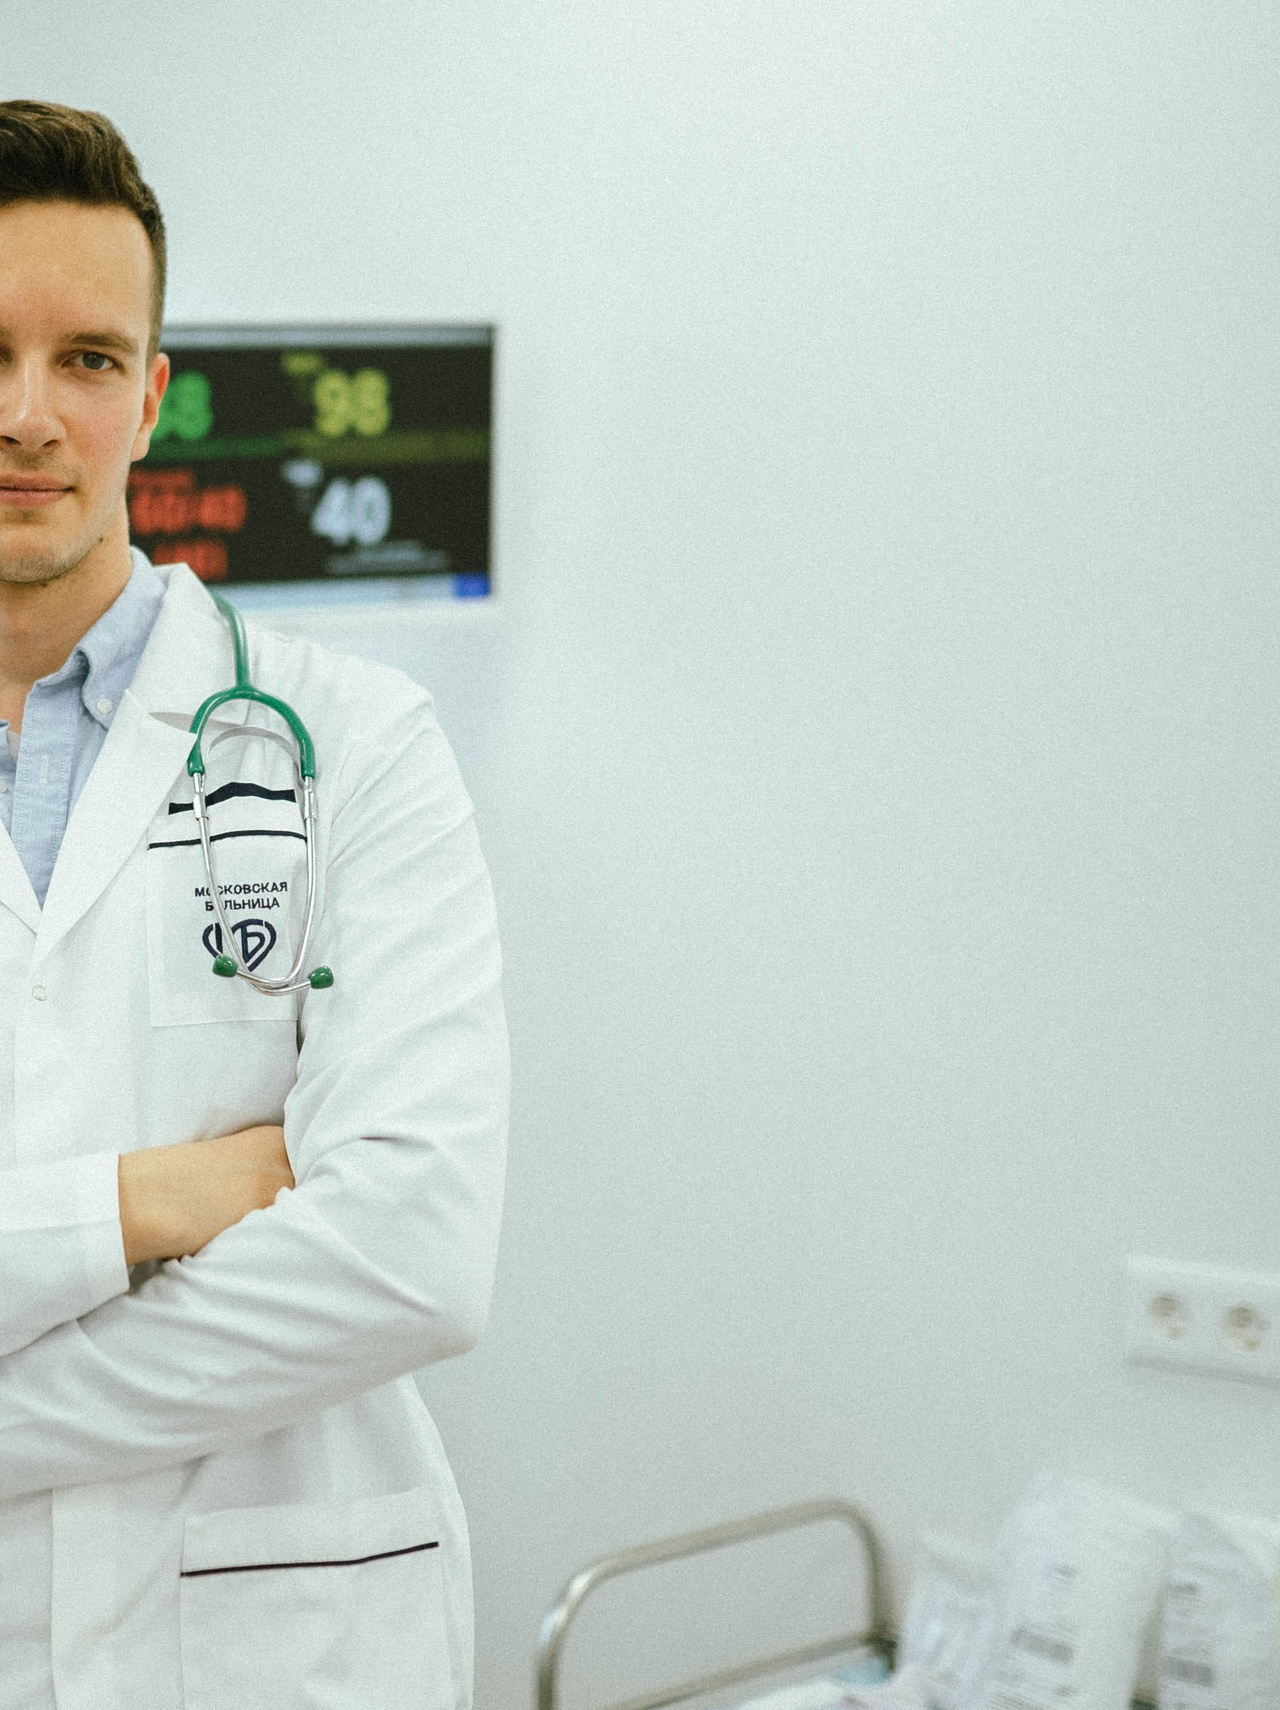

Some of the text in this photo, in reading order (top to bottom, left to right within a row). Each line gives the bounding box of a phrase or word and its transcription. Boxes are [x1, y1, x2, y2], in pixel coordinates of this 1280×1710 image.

[313, 367, 393, 437] 98
[310, 475, 392, 545] 40
[205, 896, 280, 911] БЛЬНИЦА
